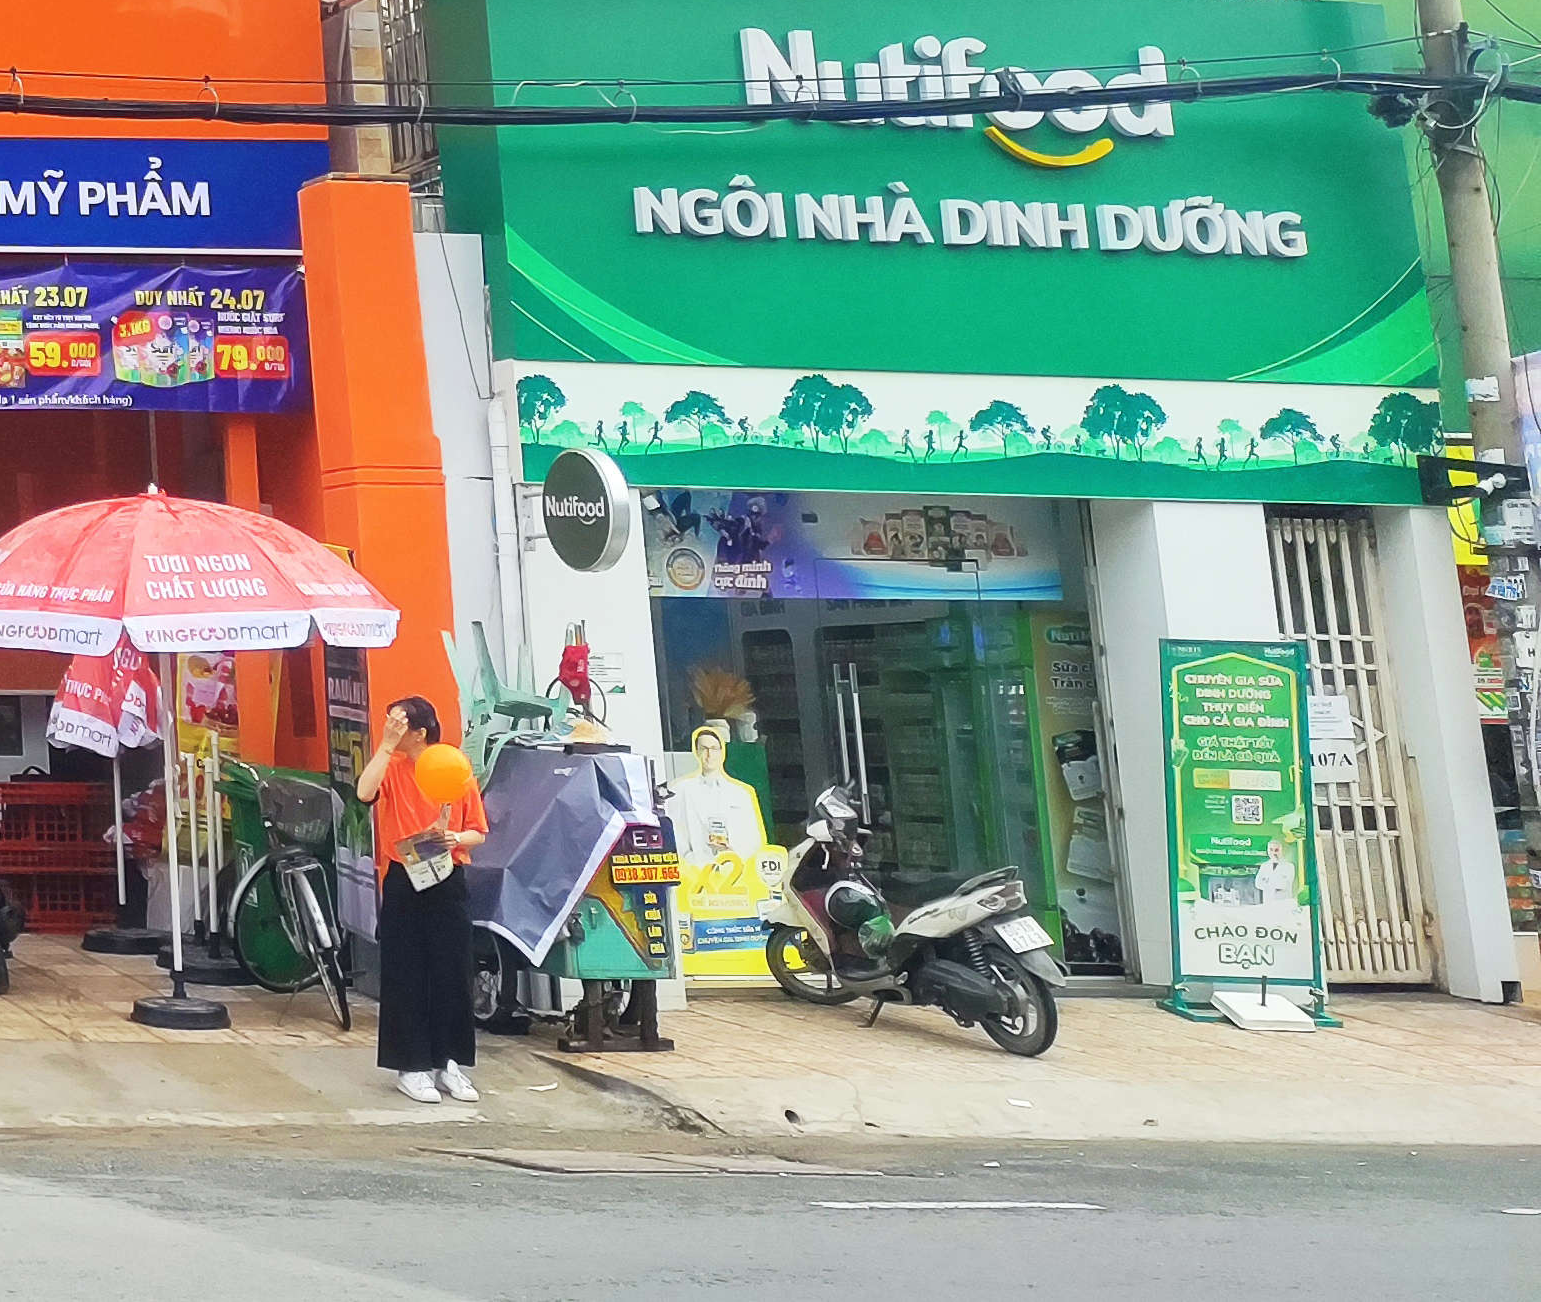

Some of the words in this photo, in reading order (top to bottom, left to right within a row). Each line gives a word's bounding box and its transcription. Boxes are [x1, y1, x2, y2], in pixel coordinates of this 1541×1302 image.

[740, 25, 1174, 140] Nutifood
[79, 157, 210, 217] PHẨM
[633, 173, 786, 240] NGÔI
[796, 179, 935, 245] NHÀ
[940, 197, 1089, 251] DINH
[1097, 193, 1309, 259] DƯỠNG
[34, 287, 88, 307] 23.07
[135, 290, 162, 306] DUY
[167, 286, 205, 306] NHẤT
[210, 289, 264, 310] 24.07
[30, 342, 96, 368] 59.000
[217, 344, 285, 371] 79.000
[545, 495, 605, 519] Nutifood
[144, 553, 193, 574] TƯƠI
[196, 553, 250, 573] NGON
[16, 580, 47, 600] HÀNG
[49, 583, 80, 604] THỰC
[82, 583, 115, 604] PHẨM
[145, 576, 196, 601] CHẤT
[200, 576, 268, 602] LƯỢNG
[1235, 676, 1255, 686] GIA
[1194, 920, 1248, 941] CHÀO
[1254, 926, 1298, 944] ĐÓN
[1219, 942, 1274, 969] BẠN
